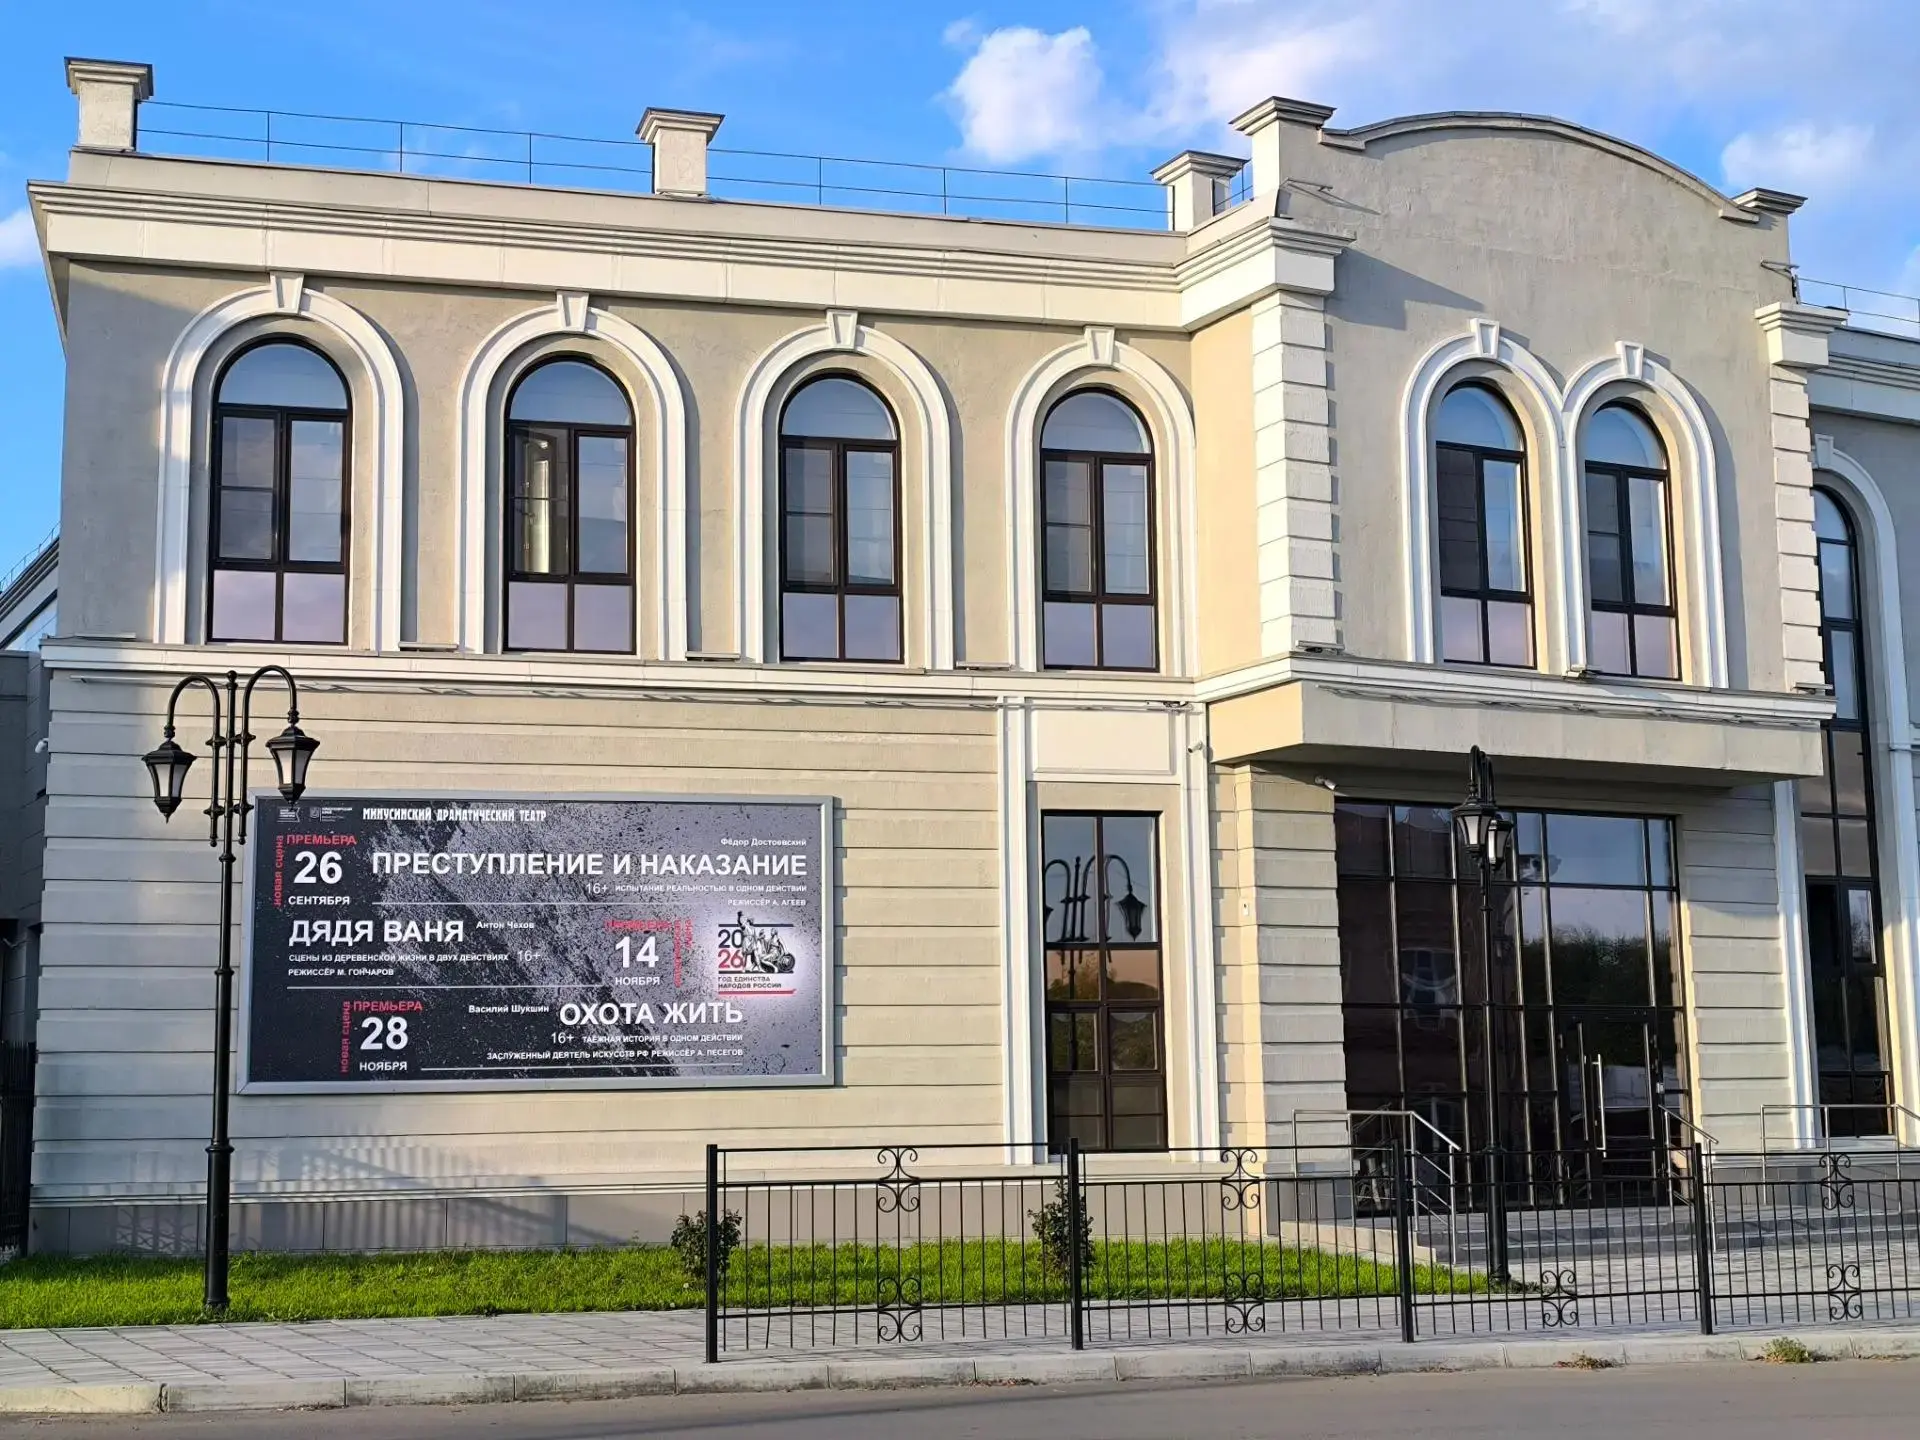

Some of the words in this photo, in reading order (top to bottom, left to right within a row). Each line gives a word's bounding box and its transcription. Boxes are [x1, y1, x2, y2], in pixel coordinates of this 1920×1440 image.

[363, 807, 432, 821] МИНУСИНСКИЙ
[436, 808, 515, 822] ДРАМАТИЧЕСКИЙ
[519, 810, 547, 822] ТЕАТР
[286, 834, 357, 845] ПРЕМЬЕРА
[720, 838, 749, 848] Фёдор
[751, 838, 807, 847] Достоевский
[293, 851, 343, 884] 26
[372, 852, 604, 875] ПРЕСТУПЛЕНИЕ
[613, 854, 631, 875] И
[641, 854, 807, 876] НАКАЗАНИЕ
[274, 871, 282, 906] новая
[585, 882, 608, 894] 16+
[615, 885, 665, 893] ИСПЫТАНИЕ
[667, 885, 727, 893] РЕАЛЬНОСТЬЮ
[728, 885, 734, 893] В
[736, 885, 764, 893] ОДНОМ
[766, 885, 807, 893] ДЕЙСТВИИ
[288, 896, 350, 905] СЕНТЯБРЯ
[781, 898, 807, 906] АГЕЕВ
[476, 921, 505, 929] Антон
[507, 921, 535, 929] Чехов
[289, 920, 373, 946] ДЯДЯ
[384, 920, 464, 942] ВАНЯ
[718, 930, 743, 949] 20
[289, 954, 320, 963] СЦЕНЫ
[322, 954, 333, 962] ИЗ
[334, 953, 396, 963] ДЕРЕВЕНСКОЙ
[398, 953, 427, 962] ЖИЗНИ
[429, 953, 435, 962] В
[437, 953, 458, 962] ДВУХ
[460, 952, 509, 962] ДЕЙСТВИЯХ
[517, 951, 541, 962] 16+
[615, 936, 660, 969] 14
[718, 950, 744, 969] 26
[288, 967, 336, 976] РЕЖИССЁР
[337, 968, 346, 976] М.
[348, 967, 395, 976] ГОНЧАРОВ
[615, 977, 661, 986] НОЯБРЯ
[353, 1001, 423, 1012] ПРЕМЬЕРА
[468, 1004, 509, 1013] Василий
[511, 1004, 550, 1014] Шукшин
[559, 1003, 655, 1026] ОХОТА
[663, 1002, 743, 1024] ЖИТЬ
[360, 1016, 409, 1050] 28
[551, 1032, 575, 1044] 16+
[623, 1035, 661, 1043] ИСТОРИЯ
[701, 1034, 743, 1042] ДЕЙСТВИИ
[341, 1038, 349, 1073] новая
[487, 1051, 550, 1060] ЗАСЛУЖЕННЫЙ
[552, 1051, 591, 1060] ДЕЯТЕЛЬ
[592, 1050, 635, 1059] ИСКУССТВ
[637, 1050, 649, 1058] РФ
[707, 1049, 743, 1057] ПЕСЕГОВ
[359, 1061, 408, 1071] НОЯБРЯ
